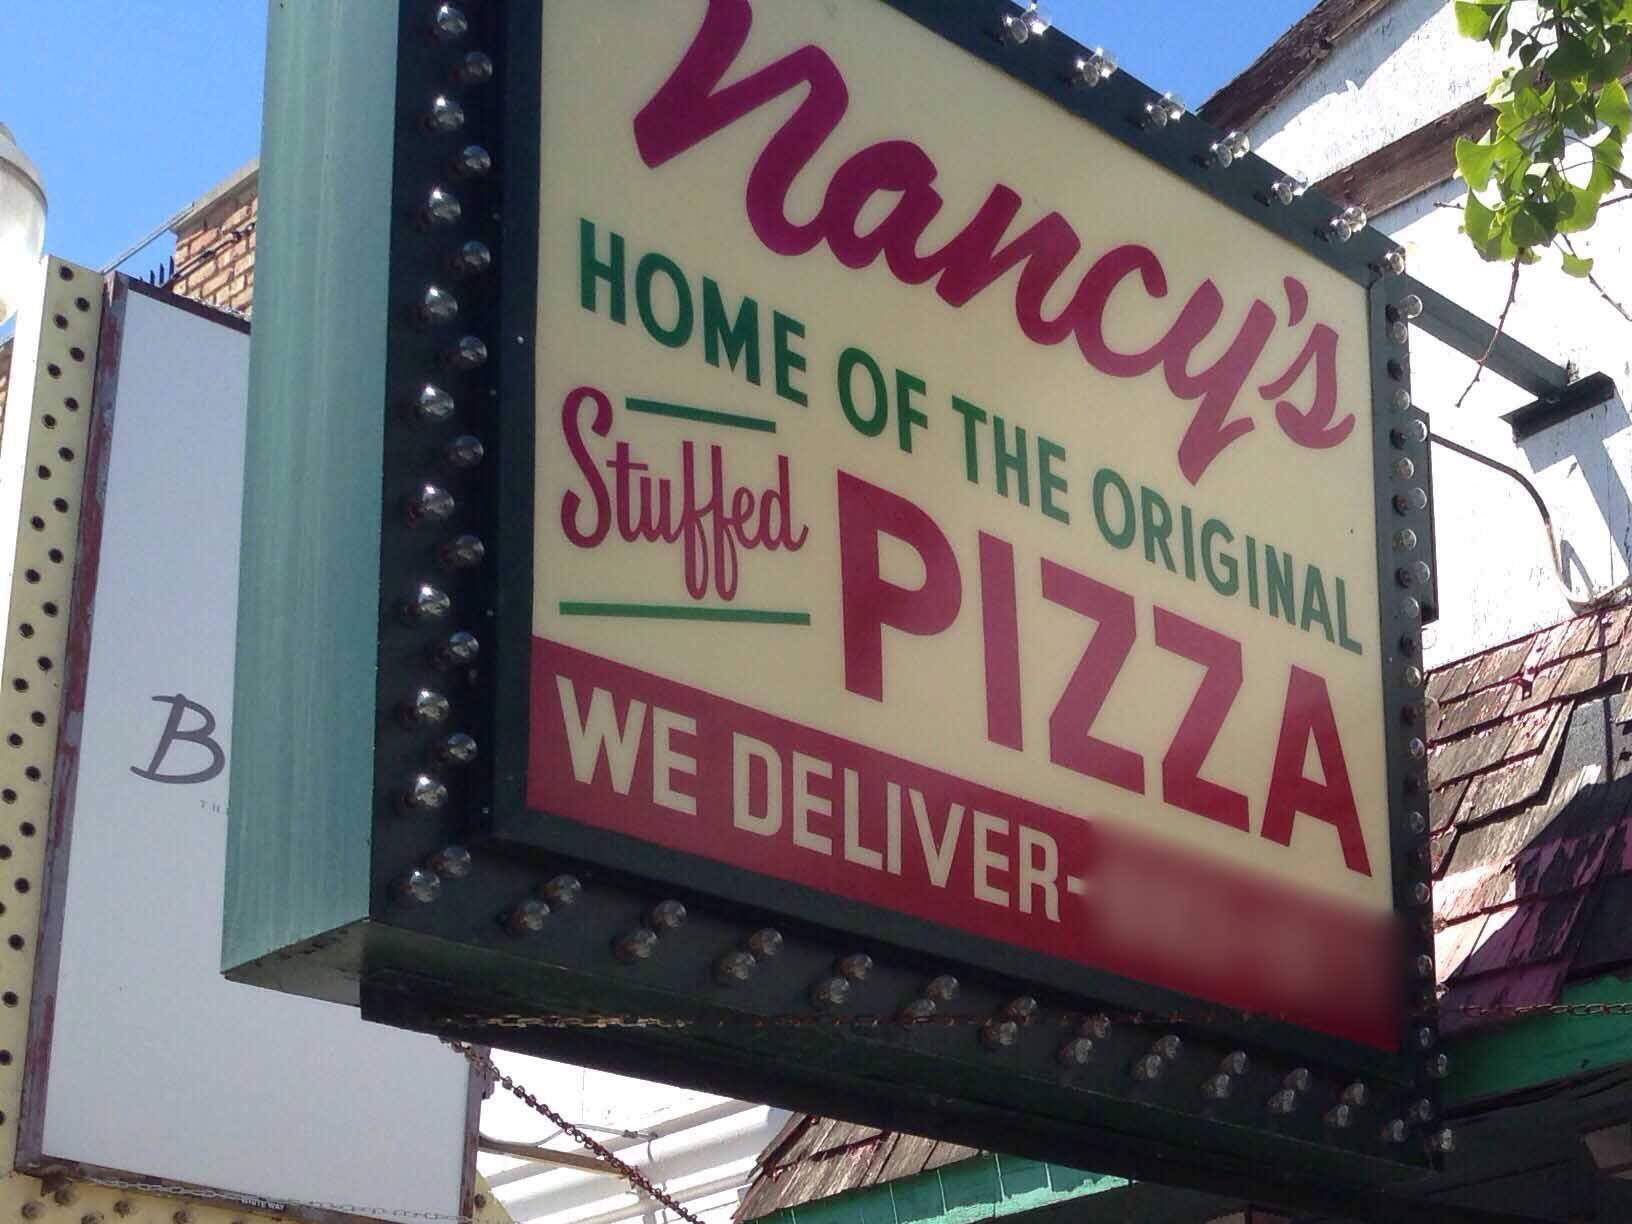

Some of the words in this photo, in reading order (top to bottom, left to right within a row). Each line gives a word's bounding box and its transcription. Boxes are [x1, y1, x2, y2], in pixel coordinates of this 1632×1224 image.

[560, 386, 808, 601] Stuffed
[577, 216, 809, 407] HOME
[836, 346, 929, 454] OF
[950, 396, 1070, 525] THE
[1092, 467, 1362, 654] ORIGINAL
[554, 675, 699, 817] WE
[836, 470, 1372, 877] PIZZA
